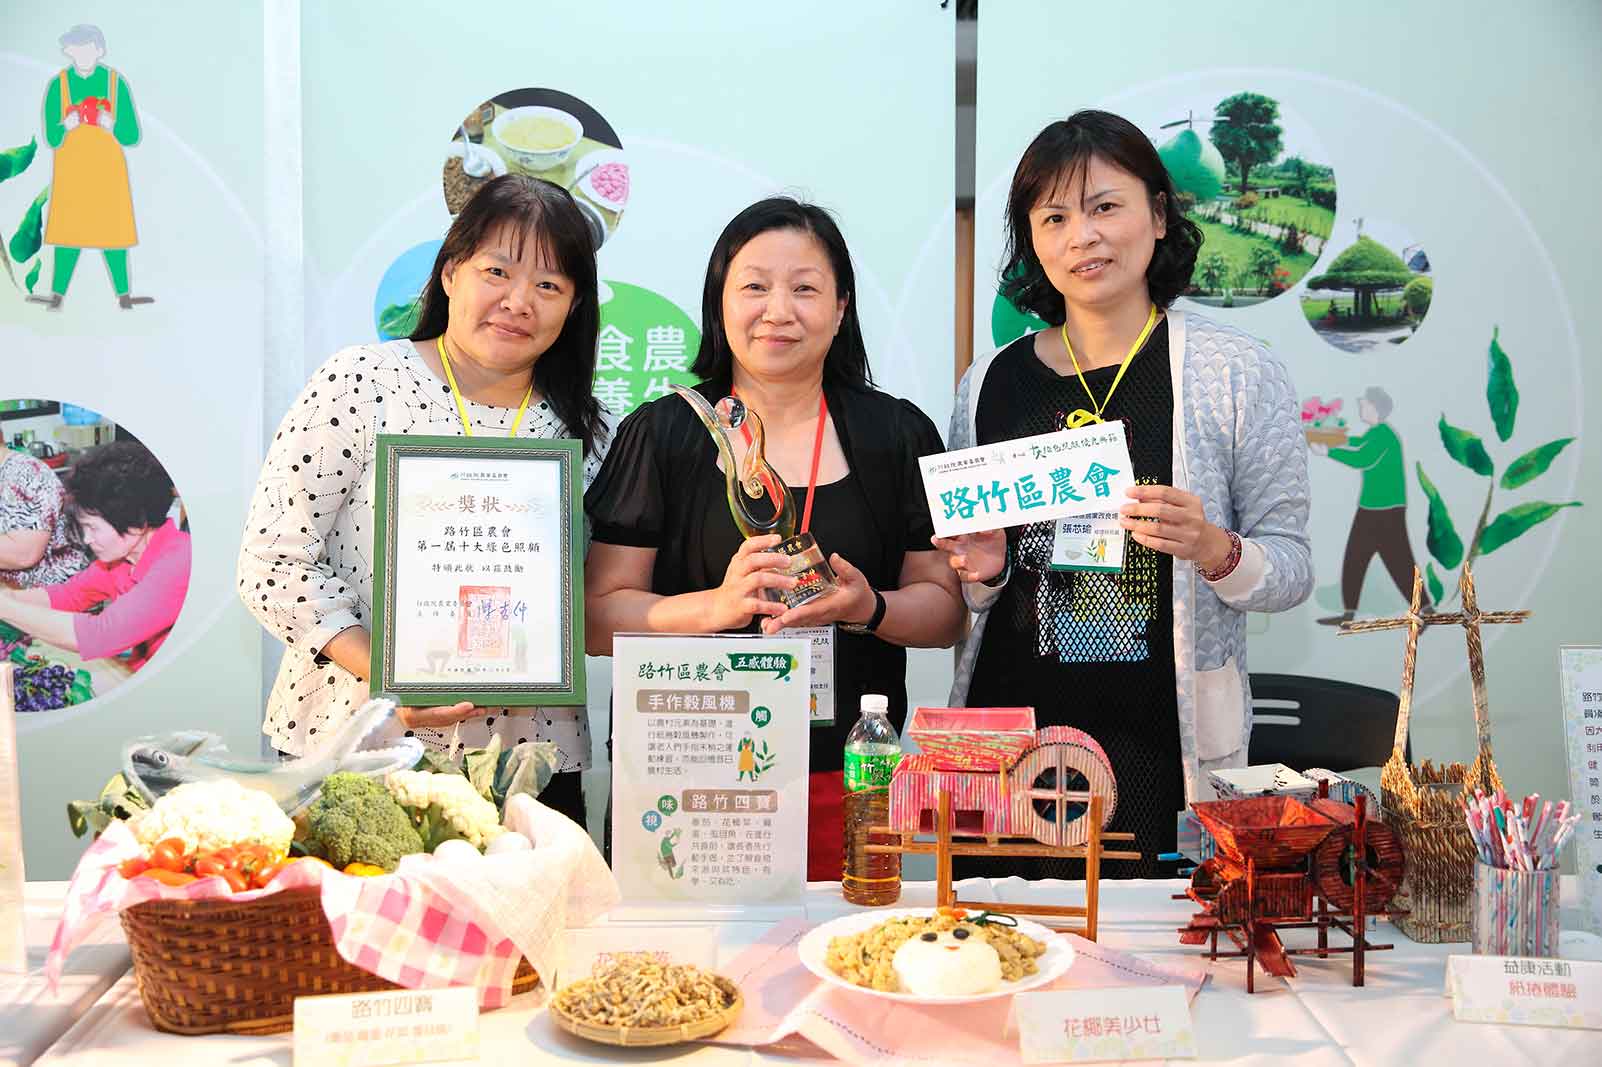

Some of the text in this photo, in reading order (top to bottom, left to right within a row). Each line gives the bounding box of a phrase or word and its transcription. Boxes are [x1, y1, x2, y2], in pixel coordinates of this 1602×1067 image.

[940, 462, 1120, 520] 路竹區農會
[457, 494, 503, 513] 獎狀
[444, 526, 512, 538] 路竹區農會
[1062, 523, 1092, 534] 張芯瑜
[417, 540, 540, 553] 第一屆十大綠色照顧
[432, 563, 474, 573] 特頒此狀
[638, 656, 787, 682] 路竹區農會 五感體驗
[648, 694, 736, 711] 手作穀風機
[691, 794, 772, 809] 路竹四寶
